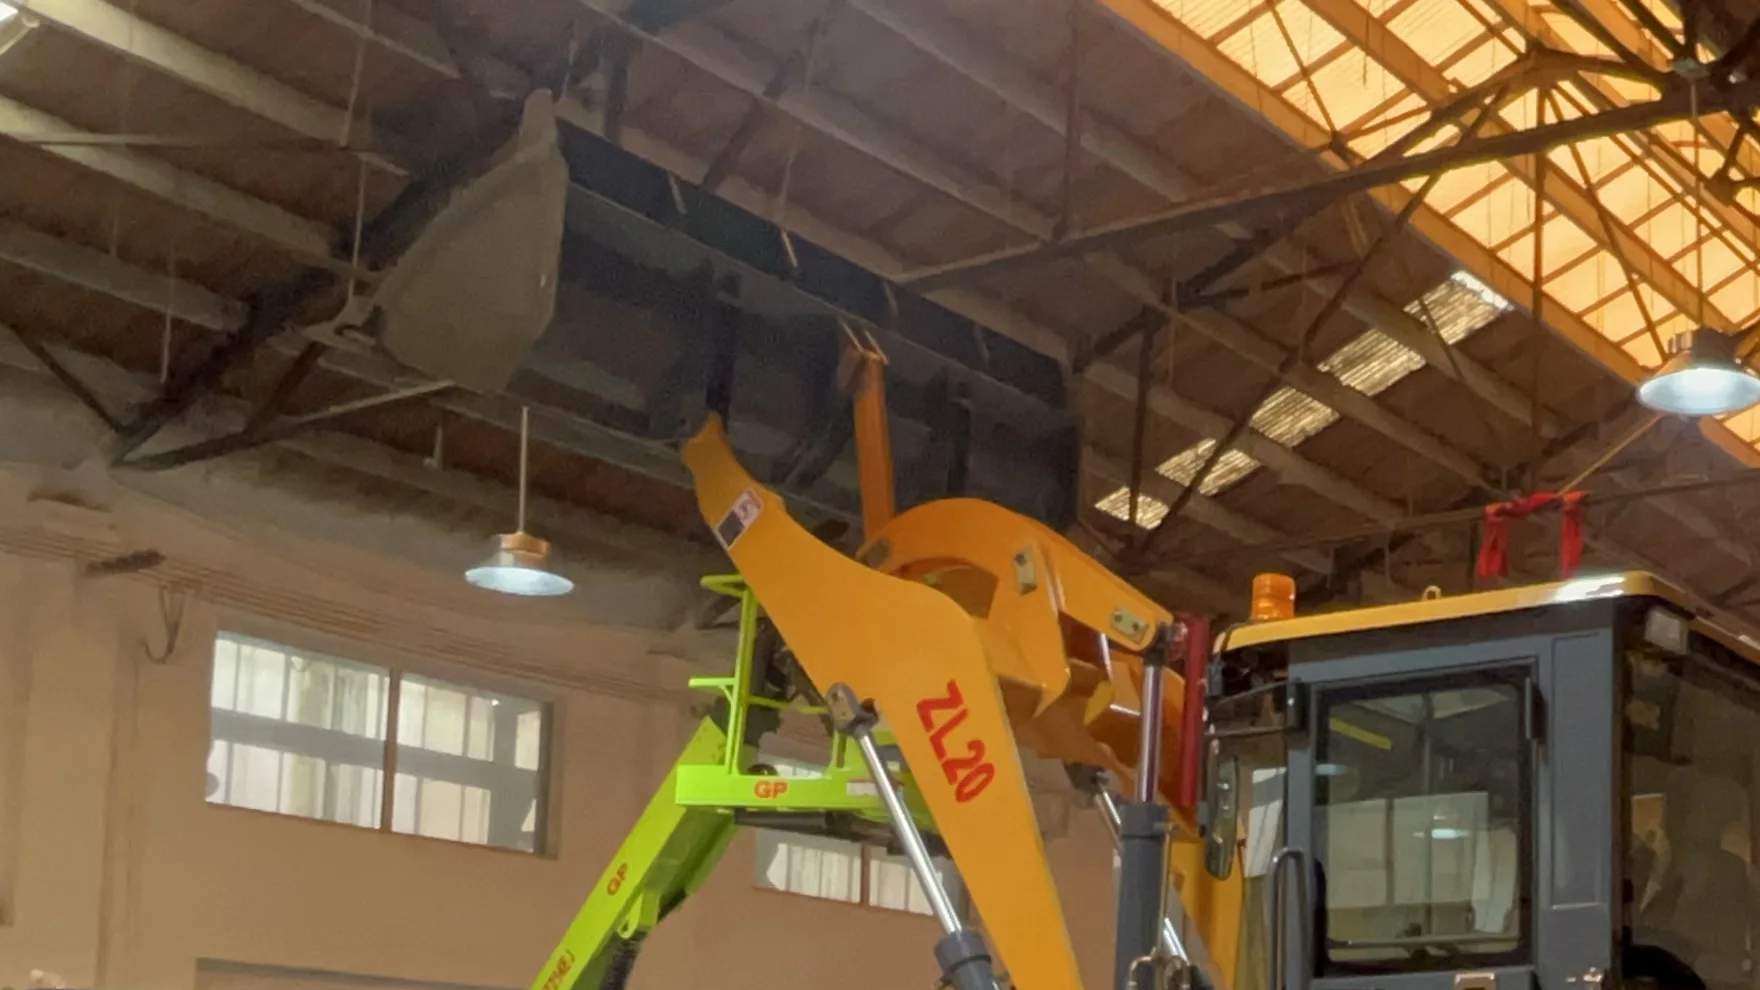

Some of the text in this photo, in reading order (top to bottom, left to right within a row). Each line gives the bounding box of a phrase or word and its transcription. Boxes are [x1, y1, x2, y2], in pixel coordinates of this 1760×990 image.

[915, 678, 996, 803] ZL20
[754, 780, 788, 798] GP
[607, 862, 628, 897] GP
